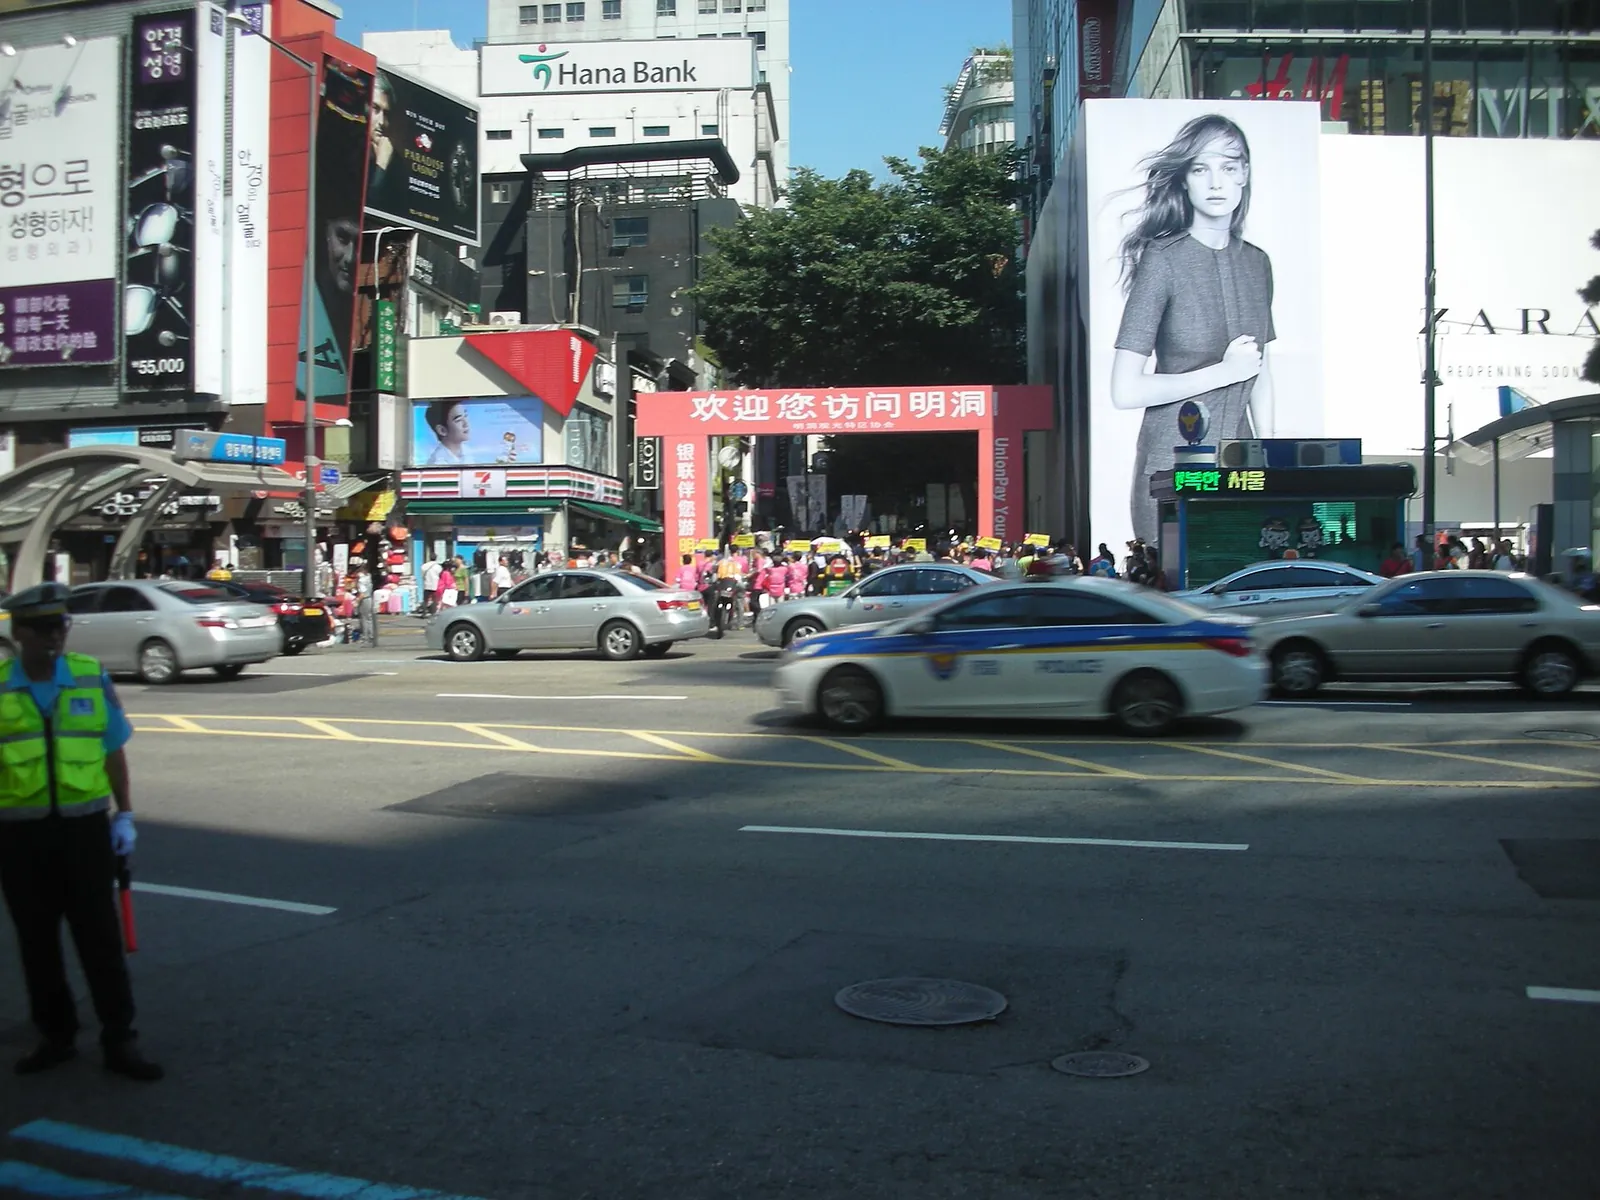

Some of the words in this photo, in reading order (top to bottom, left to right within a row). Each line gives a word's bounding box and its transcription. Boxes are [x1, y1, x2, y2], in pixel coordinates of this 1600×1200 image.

[559, 63, 626, 86] Hana
[634, 59, 697, 84] Bank
[404, 148, 445, 172] PARADISE
[412, 162, 438, 179] CASINO
[8, 205, 94, 240] 성형하자!
[1420, 306, 1600, 338] ZARA
[1446, 365, 1534, 379] REOPENING
[1541, 365, 1583, 379] SOON
[690, 389, 986, 422] 欢迎您访问明洞
[993, 437, 1009, 502] UnionPay
[1227, 471, 1266, 491] 서울
[994, 506, 1009, 538] Your
